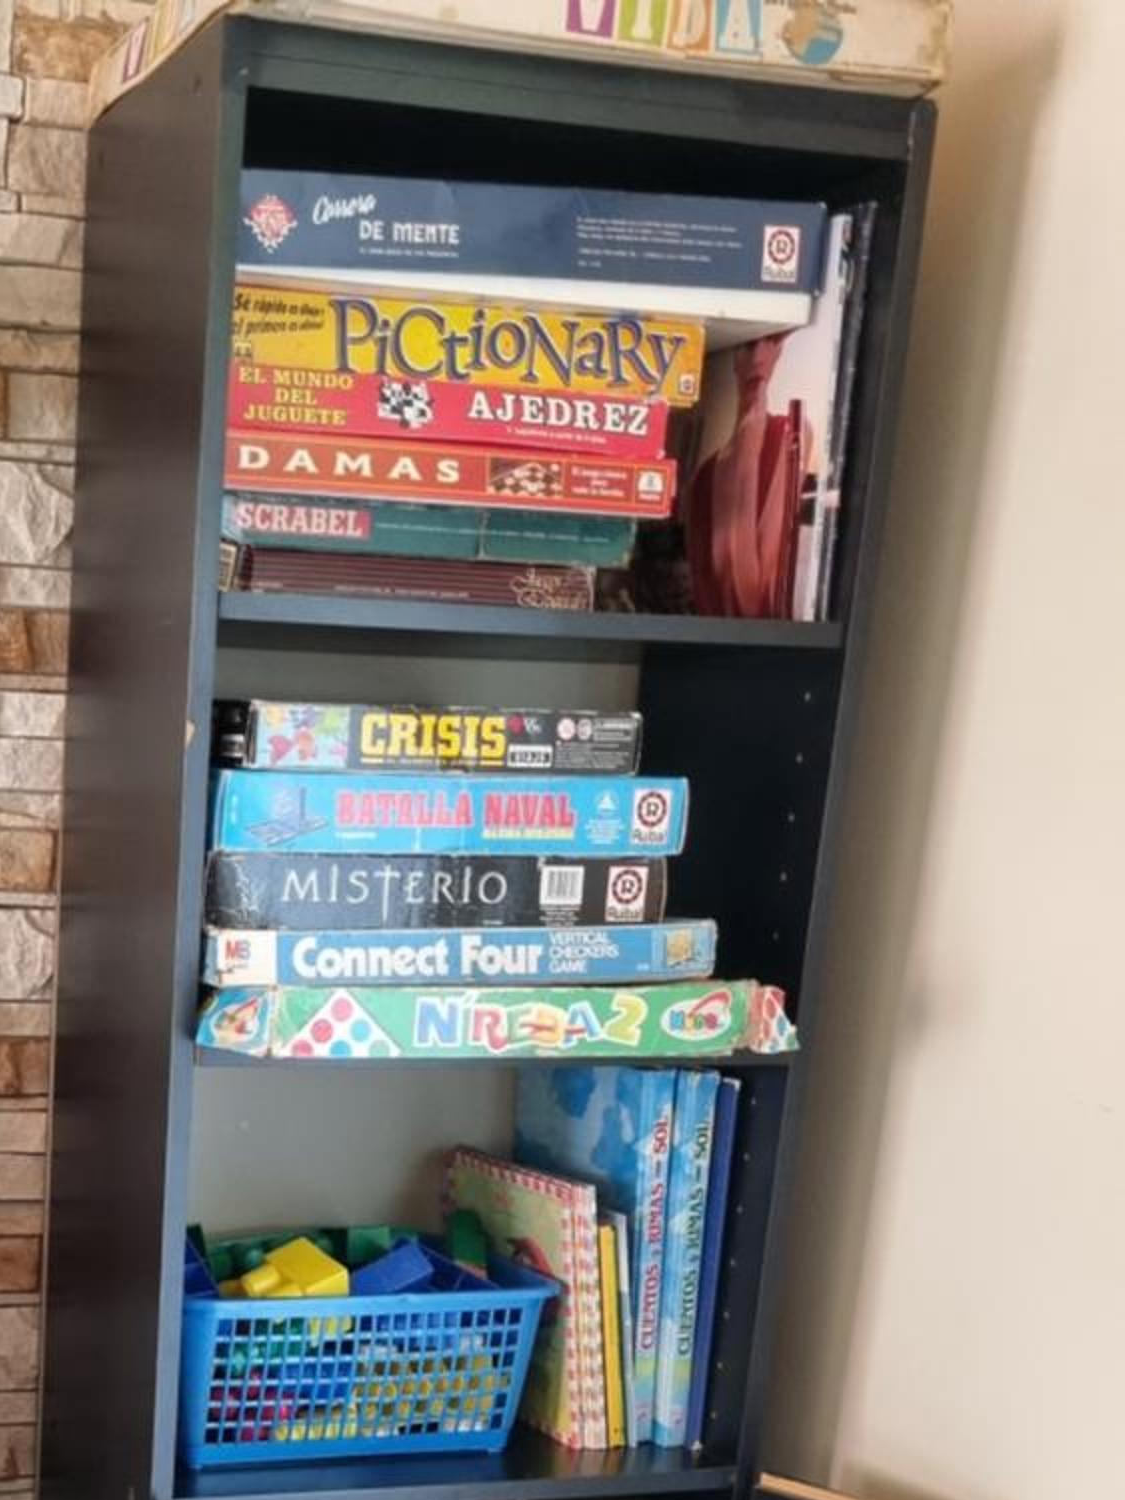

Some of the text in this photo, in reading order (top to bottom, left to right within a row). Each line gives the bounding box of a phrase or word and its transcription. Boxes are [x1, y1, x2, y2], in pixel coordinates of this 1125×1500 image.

[359, 219, 461, 245] DE MENTE
[239, 367, 353, 389] EL MUNDO
[275, 389, 316, 405] DEL
[468, 391, 649, 436] AJEDREZ
[243, 404, 346, 425] JUGUETE
[238, 445, 460, 483] DAMAS
[235, 502, 364, 537] SCRABEL
[361, 714, 506, 758] CRISIS
[484, 794, 577, 828] NAVAL
[282, 864, 507, 922] MISTERIO
[226, 940, 250, 960] MB
[293, 934, 544, 978] Connect Four
